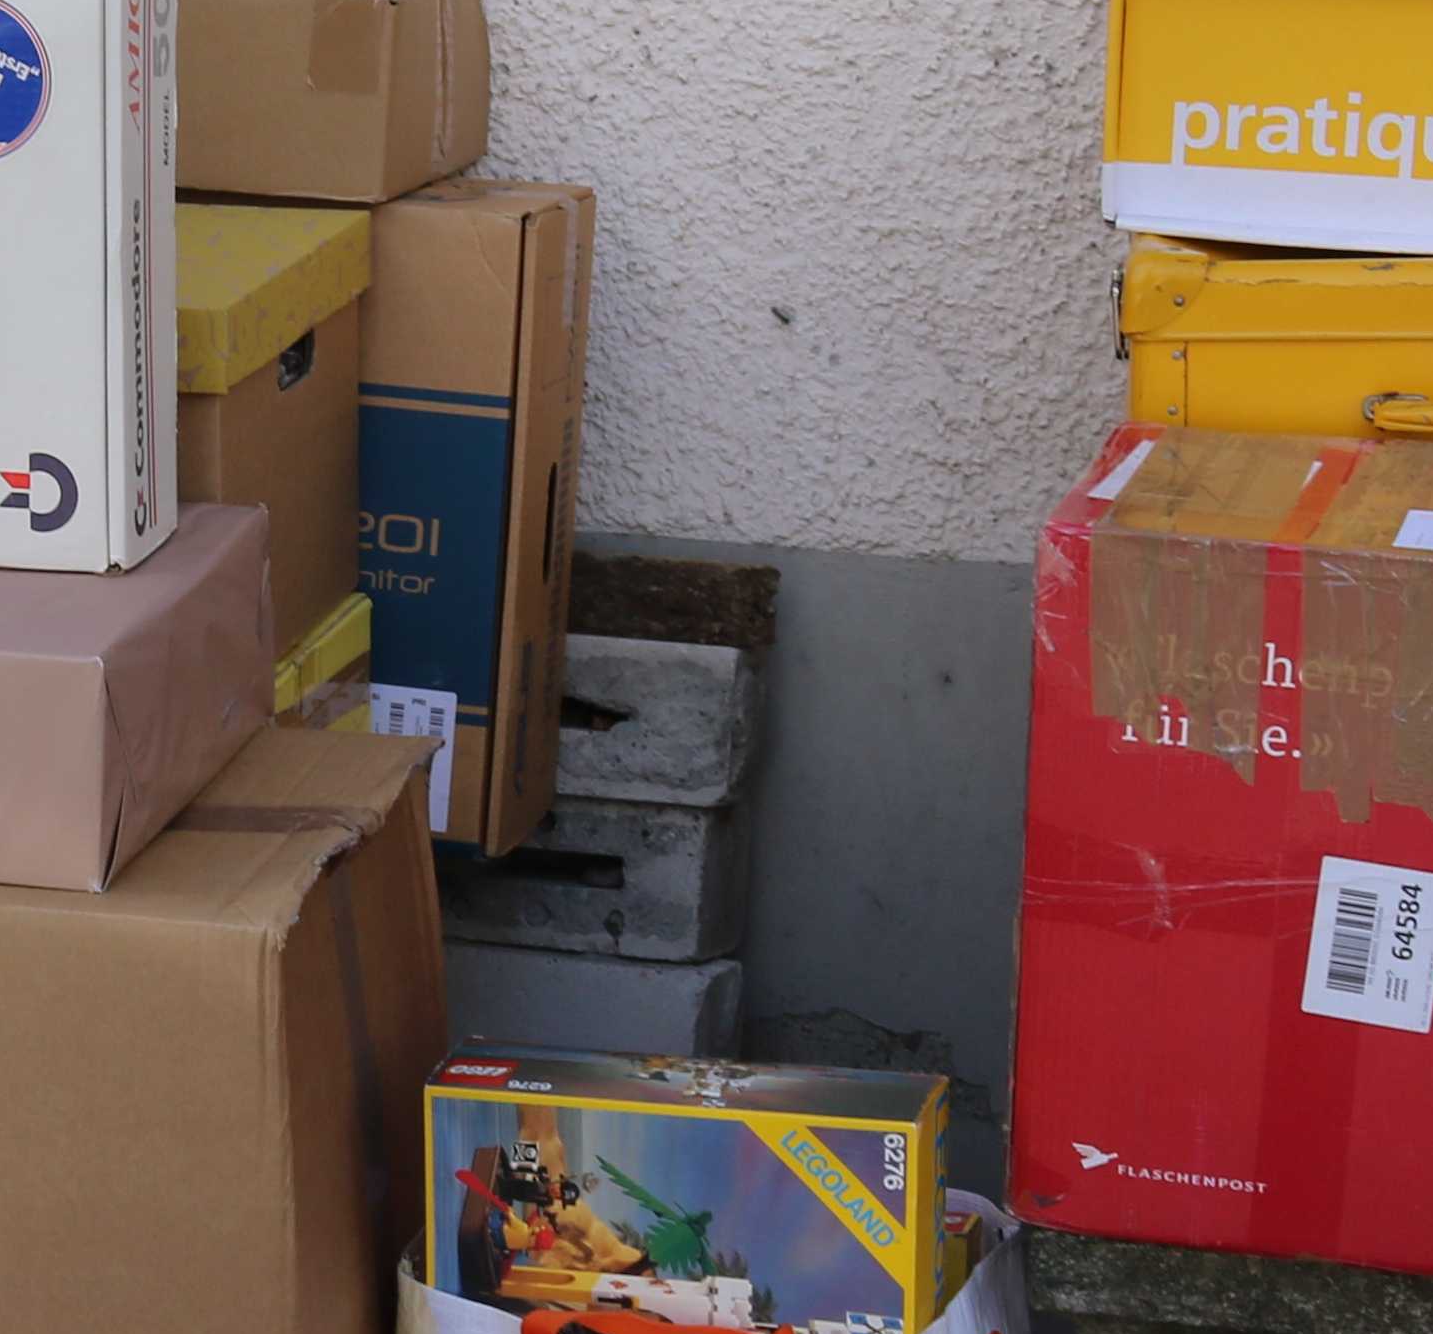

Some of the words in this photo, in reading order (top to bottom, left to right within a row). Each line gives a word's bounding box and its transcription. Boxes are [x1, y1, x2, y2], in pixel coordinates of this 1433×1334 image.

[1391, 882, 1424, 962] 64584
[507, 1078, 553, 1092] 6276
[779, 1129, 896, 1248] LEGOLAND
[882, 1133, 906, 1191] 6276
[1116, 1163, 1269, 1194] FLASCHENPOST
